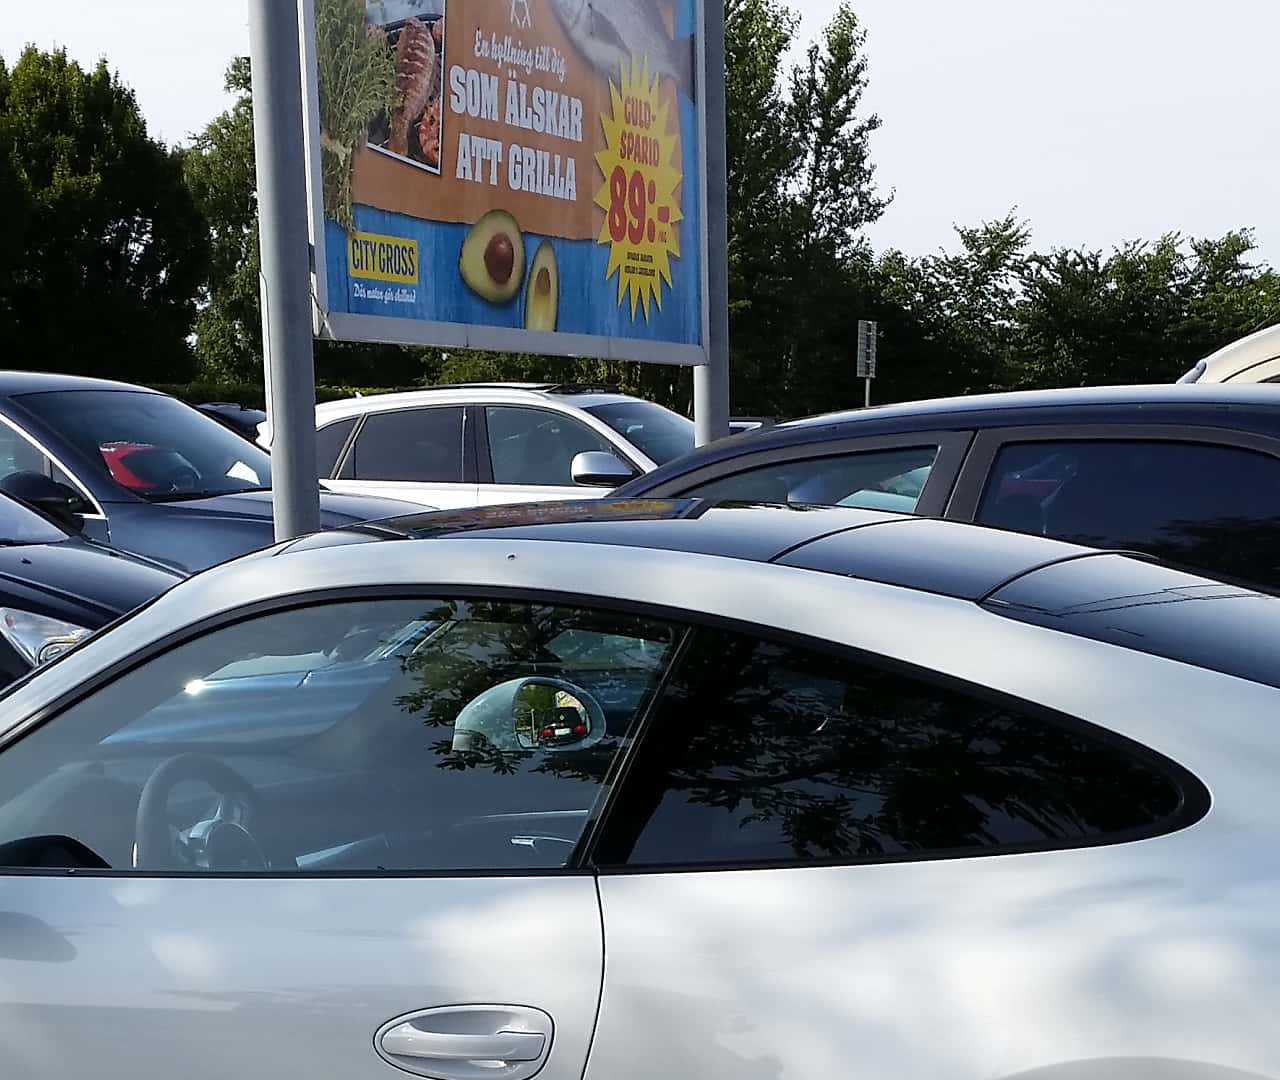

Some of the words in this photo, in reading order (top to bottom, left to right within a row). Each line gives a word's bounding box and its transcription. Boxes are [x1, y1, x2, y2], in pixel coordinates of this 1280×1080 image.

[474, 29, 490, 57] En
[491, 32, 533, 75] hyllning
[535, 45, 550, 72] till
[551, 47, 566, 83] dig
[450, 65, 499, 122] SOM
[505, 69, 582, 142] ÄLSKAR
[456, 133, 502, 186] ATT
[508, 144, 577, 201] GRILLA
[352, 239, 376, 272] CITY
[379, 242, 415, 277] GROSS
